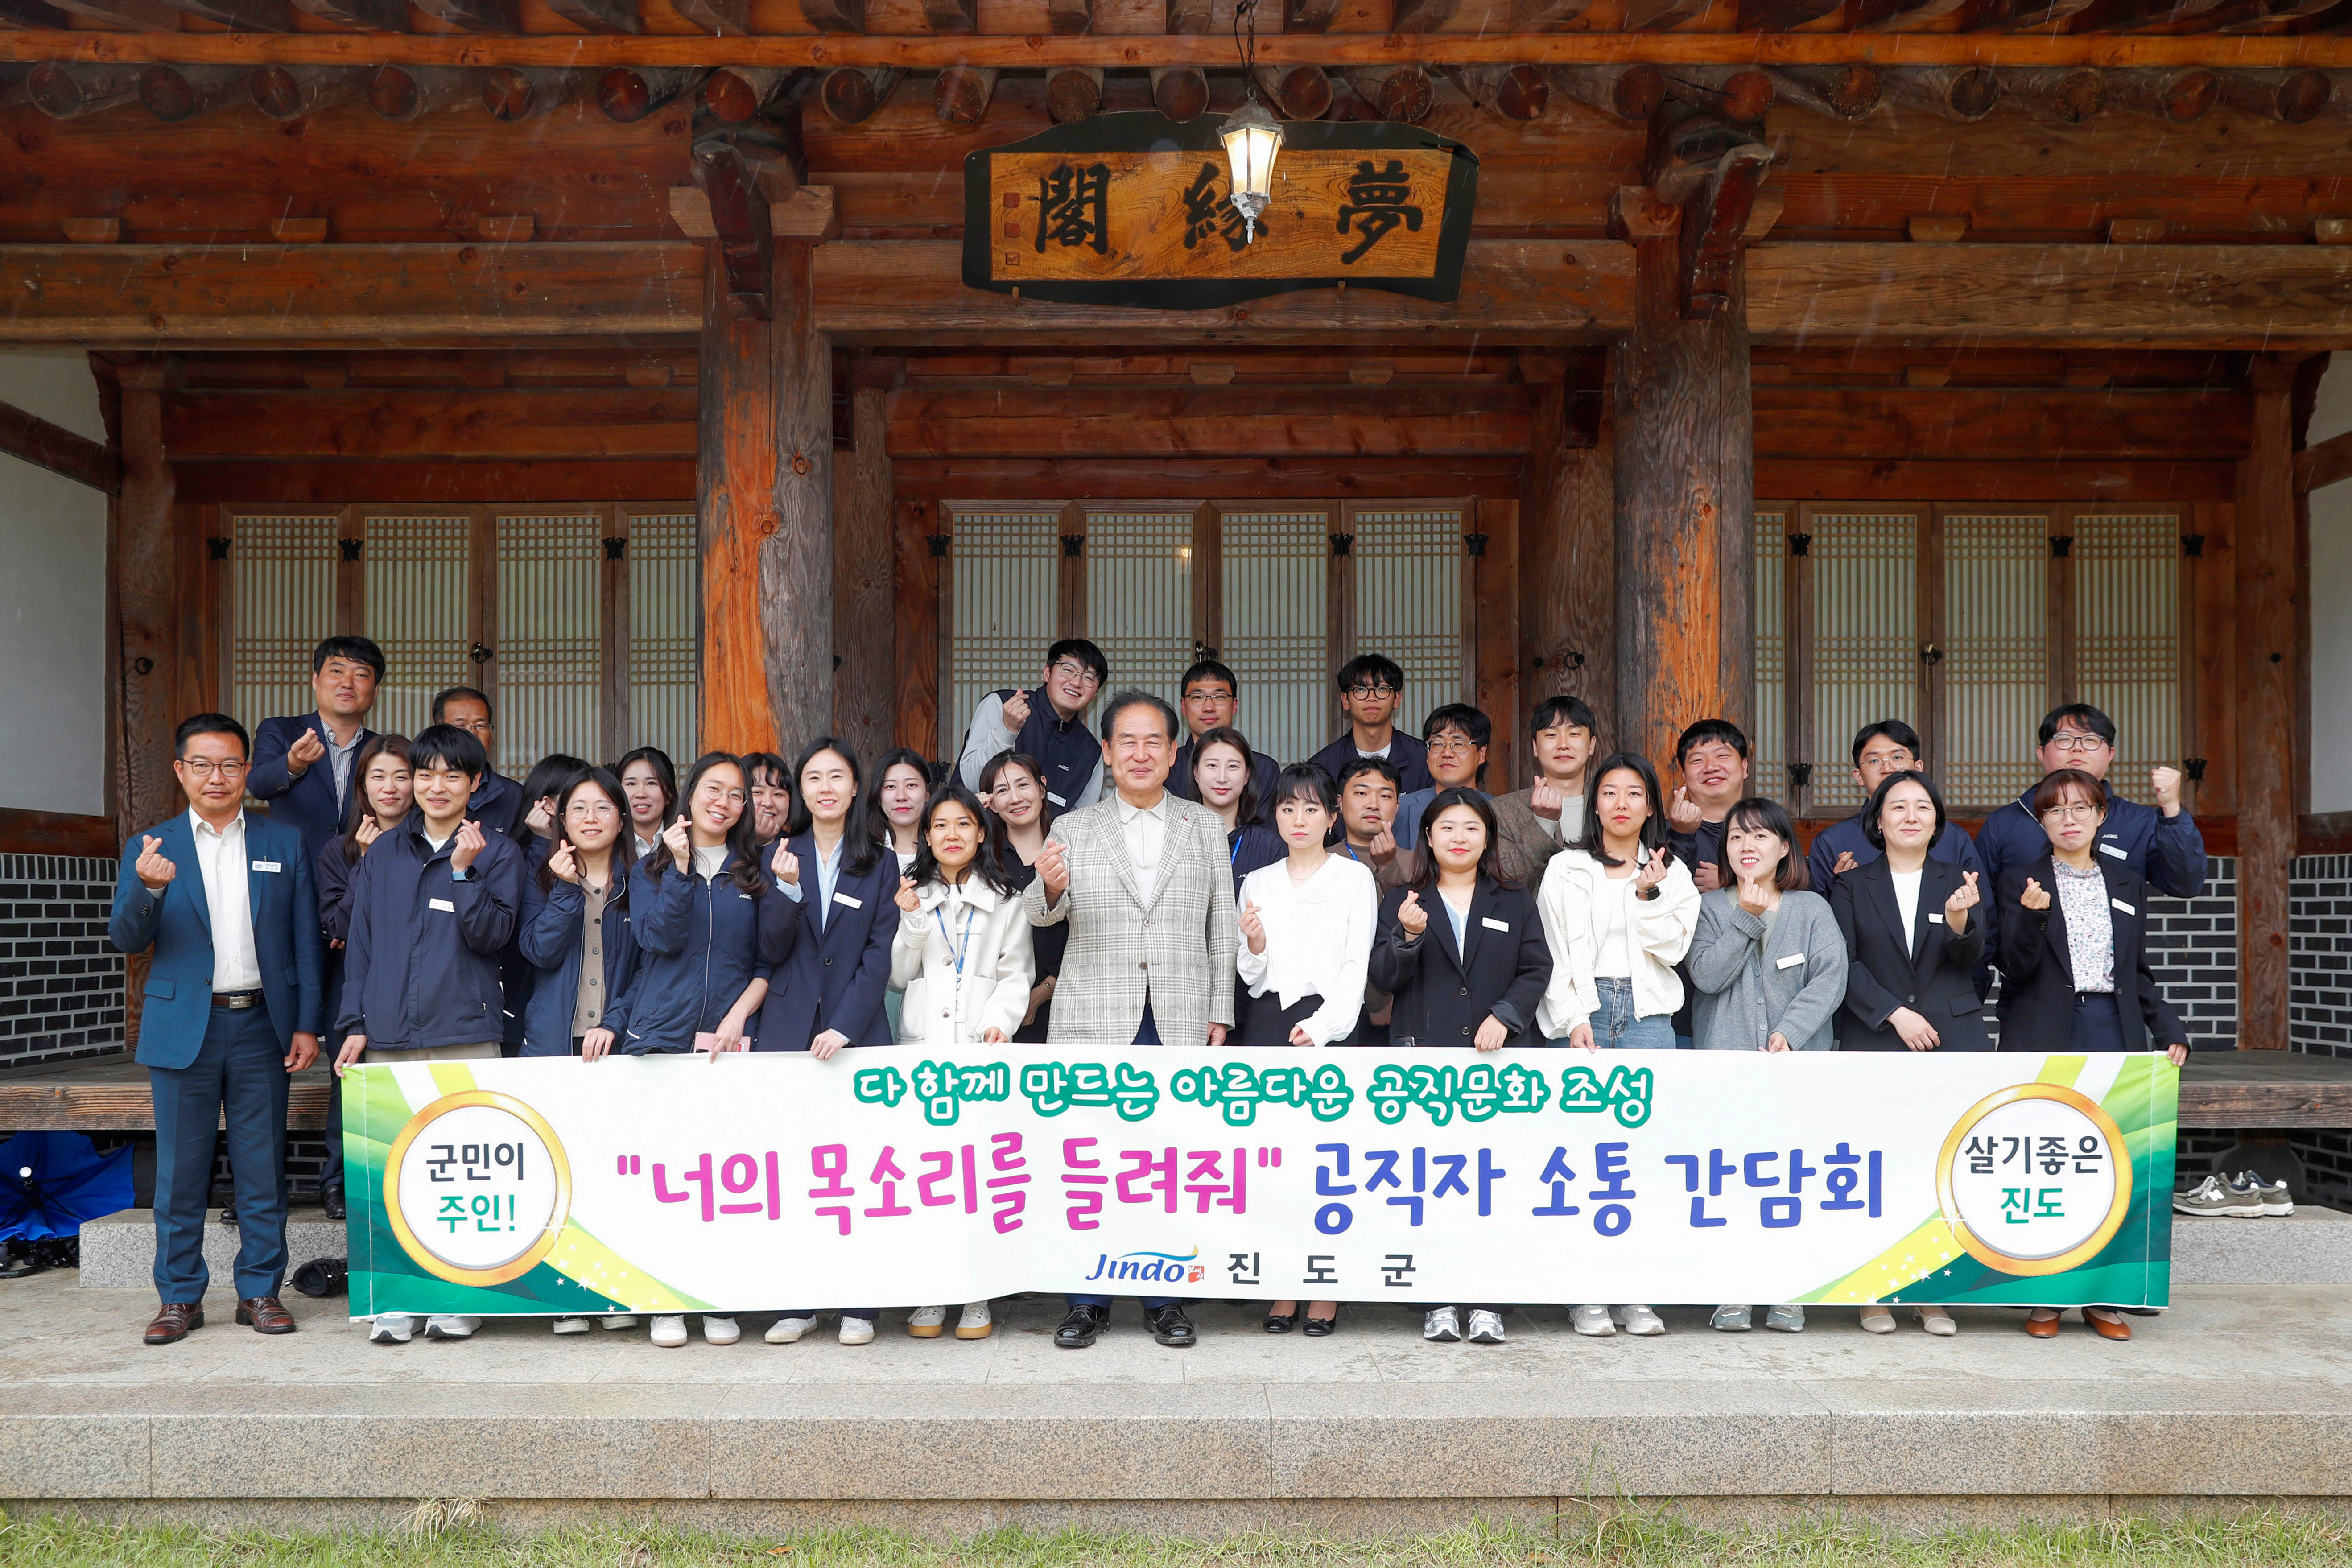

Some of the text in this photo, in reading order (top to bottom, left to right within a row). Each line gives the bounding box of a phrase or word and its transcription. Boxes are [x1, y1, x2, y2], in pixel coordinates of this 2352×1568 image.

[1021, 1062, 1159, 1121] 만드는
[1171, 1063, 1353, 1126] 아름다운
[1367, 1064, 1550, 1126] 공직문화
[1560, 1066, 1653, 1128] 조성
[426, 1143, 524, 1182] 군민이
[1964, 1135, 2103, 1176] 살기좋은
[617, 1132, 1882, 1237] "너의 목소리를 들려줘" 공직자 소통 간담회
[437, 1194, 515, 1234] 주인!
[2000, 1187, 2065, 1224] 진도
[1085, 1254, 1184, 1283] Jindo
